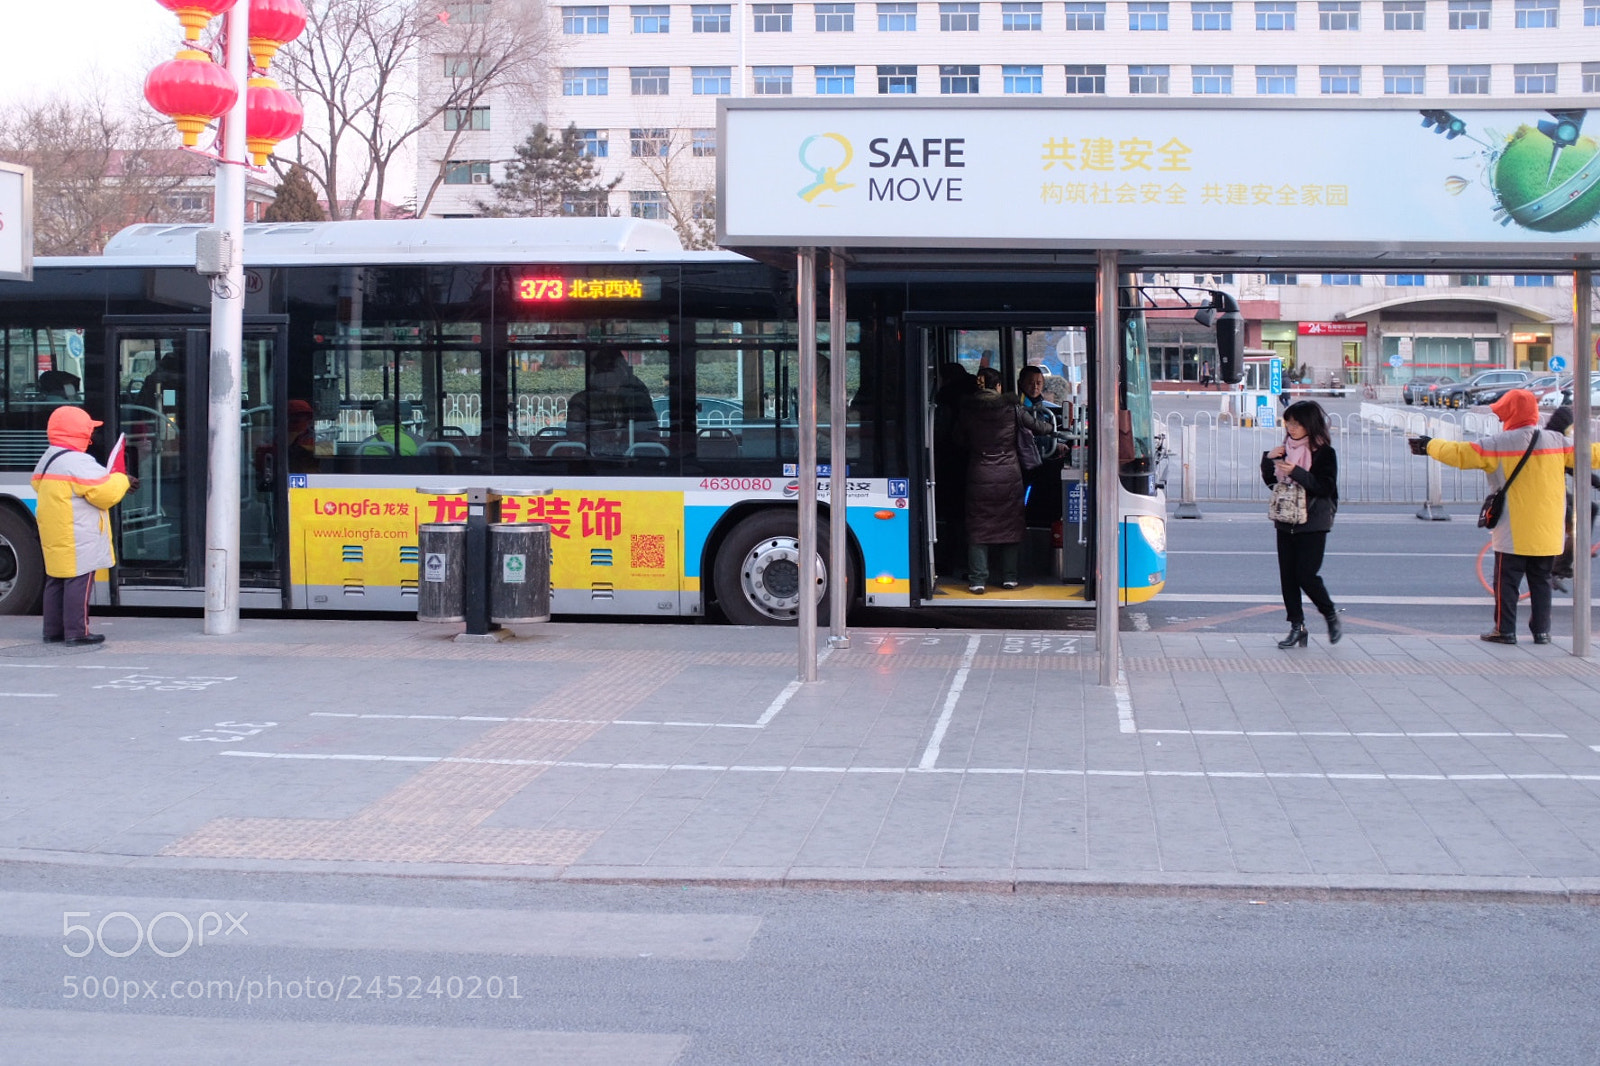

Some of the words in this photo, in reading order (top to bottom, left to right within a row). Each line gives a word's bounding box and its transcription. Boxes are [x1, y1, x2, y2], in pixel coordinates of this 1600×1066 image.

[868, 137, 966, 168] SAFE
[1040, 136, 1193, 172] 共建安全
[868, 177, 964, 202] MOVE
[1040, 182, 1188, 206] 构筑社会安全
[1201, 182, 1349, 207] 共建安全家园
[520, 279, 563, 299] 373
[568, 279, 643, 299] 北京西站
[1308, 323, 1321, 333] 24
[699, 478, 772, 491] 4630080
[314, 498, 381, 518] Longfa
[383, 503, 410, 516] 龙发
[313, 527, 408, 542] www.longfa.com
[864, 637, 943, 645] 373
[1002, 646, 1079, 655] 574
[1005, 637, 1080, 646] 527
[178, 720, 279, 743] 373
